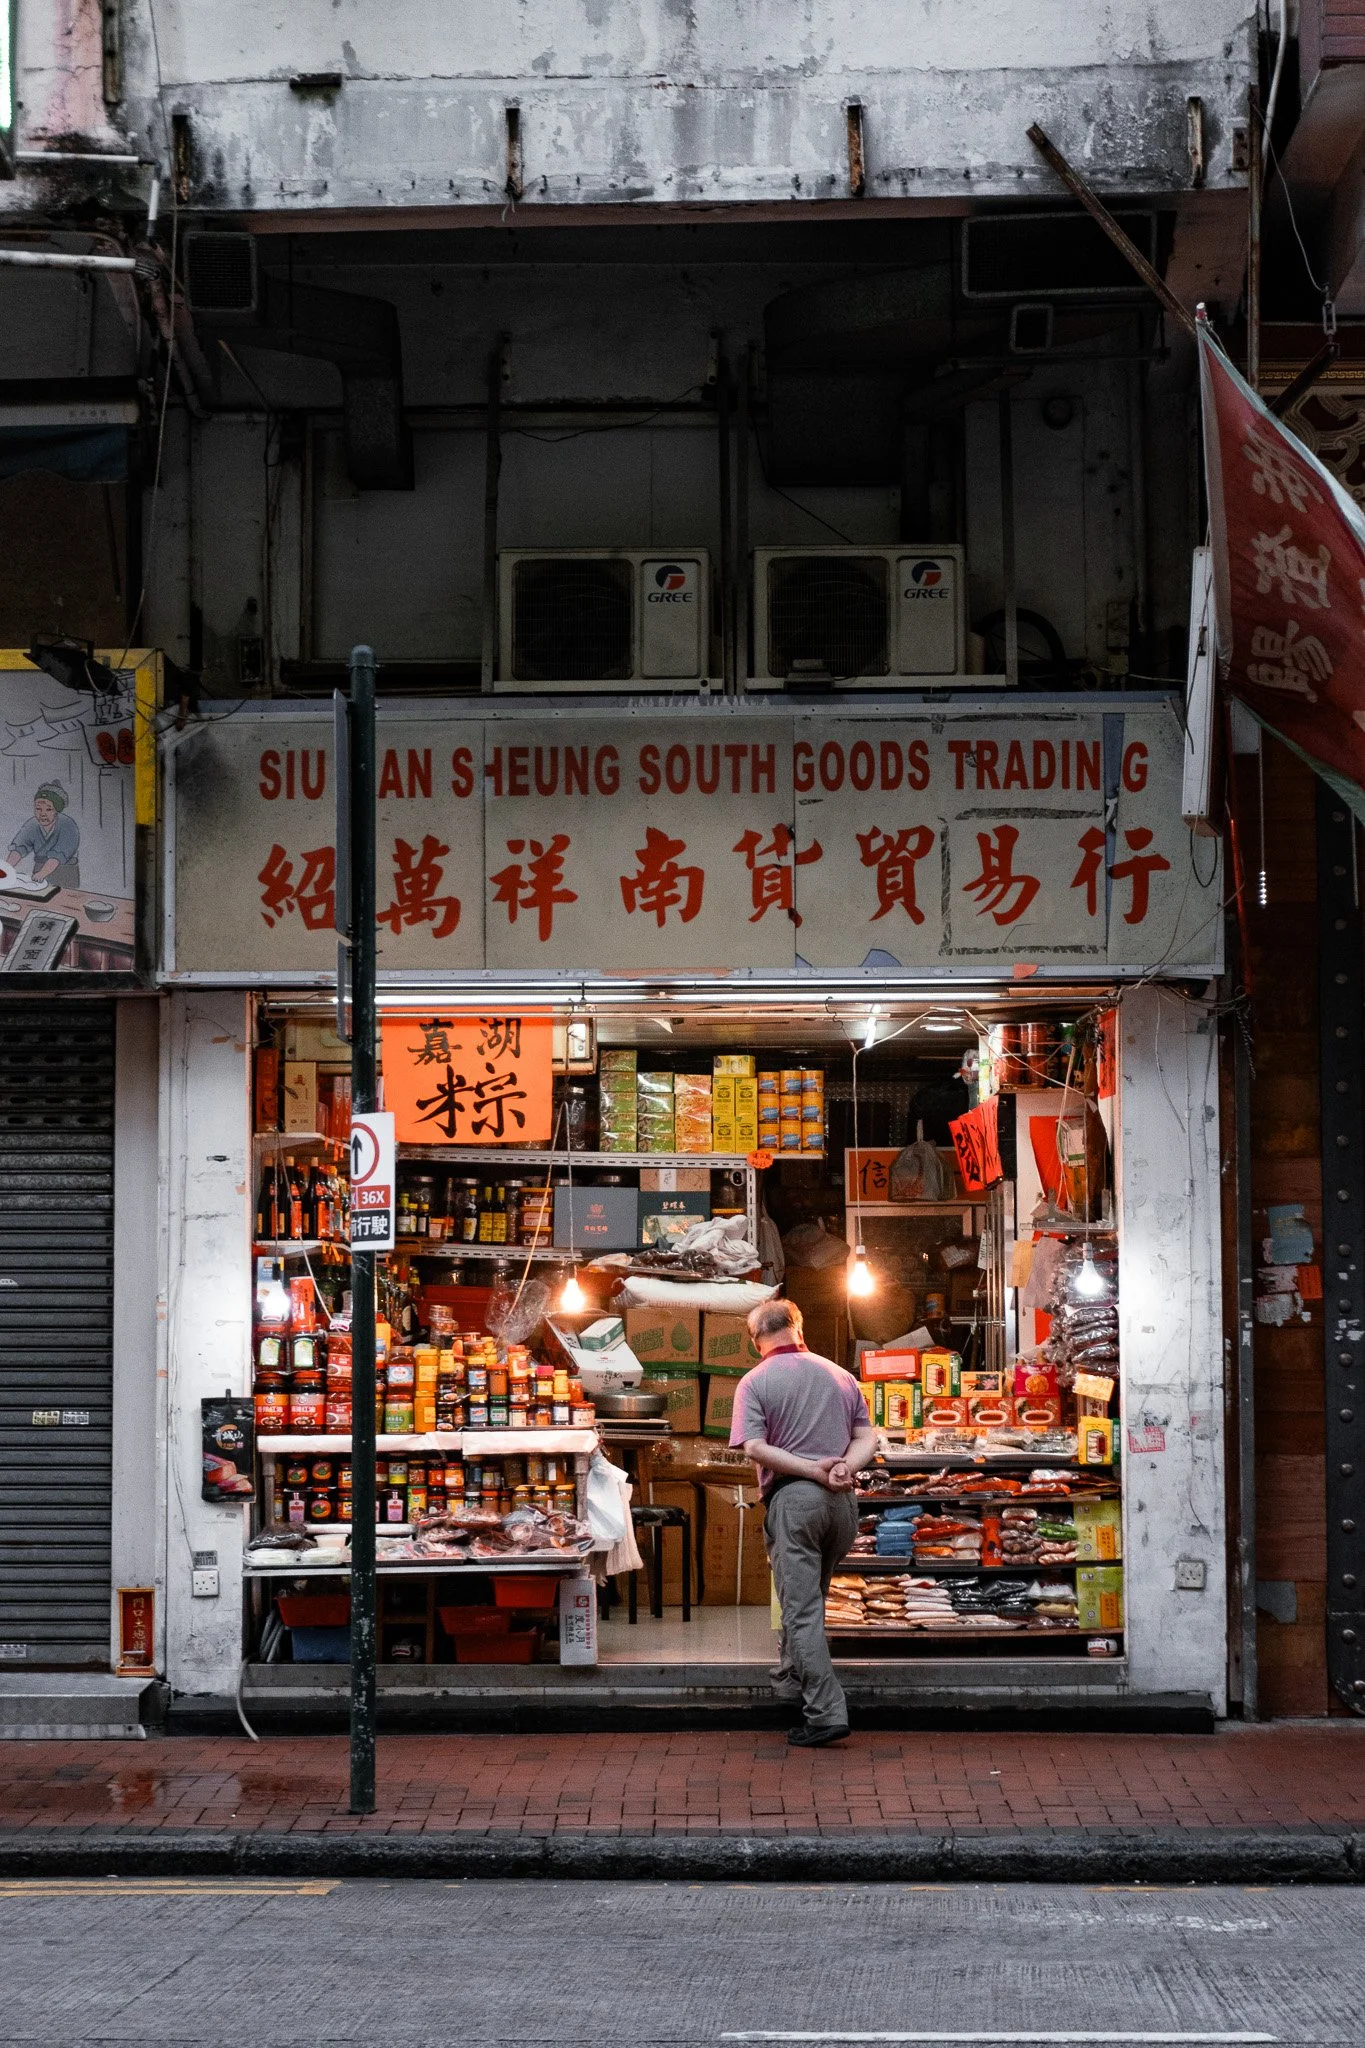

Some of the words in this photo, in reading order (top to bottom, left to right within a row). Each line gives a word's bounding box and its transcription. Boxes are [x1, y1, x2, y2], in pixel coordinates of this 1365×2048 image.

[648, 592, 693, 603] GREE
[904, 588, 949, 599] GREE
[259, 749, 326, 800] SIU
[378, 748, 432, 799] AN
[452, 745, 620, 798] SHEUNG
[639, 744, 776, 796] SOUTH
[793, 739, 931, 792] GOODS
[948, 739, 1149, 793] TRADING
[258, 824, 1171, 942] 紹萬祥南貨貿易行
[361, 1190, 385, 1205] 36X
